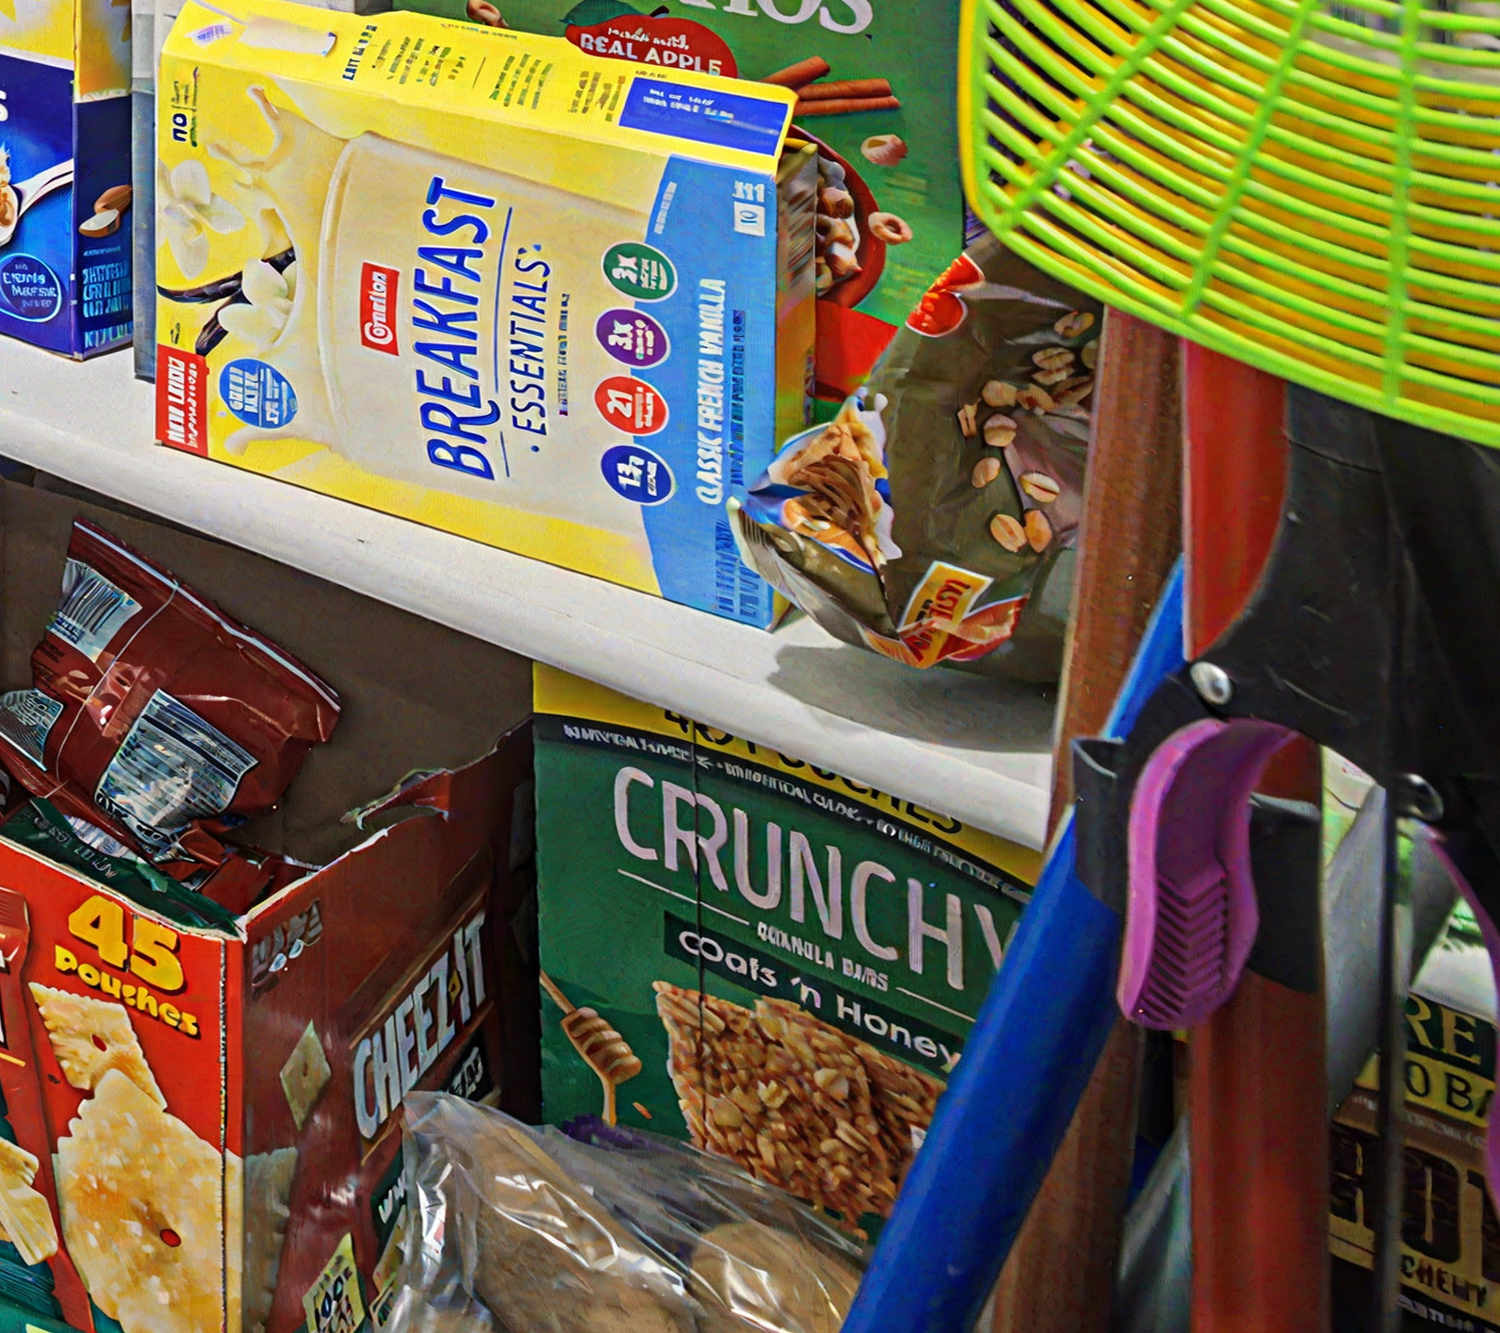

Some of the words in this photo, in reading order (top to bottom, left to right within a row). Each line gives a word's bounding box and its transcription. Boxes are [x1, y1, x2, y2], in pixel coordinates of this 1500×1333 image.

[579, 32, 638, 58] REAL
[645, 42, 724, 78] APPLE
[411, 174, 498, 481] BREAKFAST
[512, 256, 552, 437] ESSENTIALS
[53, 942, 201, 1039] Pouches
[67, 893, 188, 994] 45
